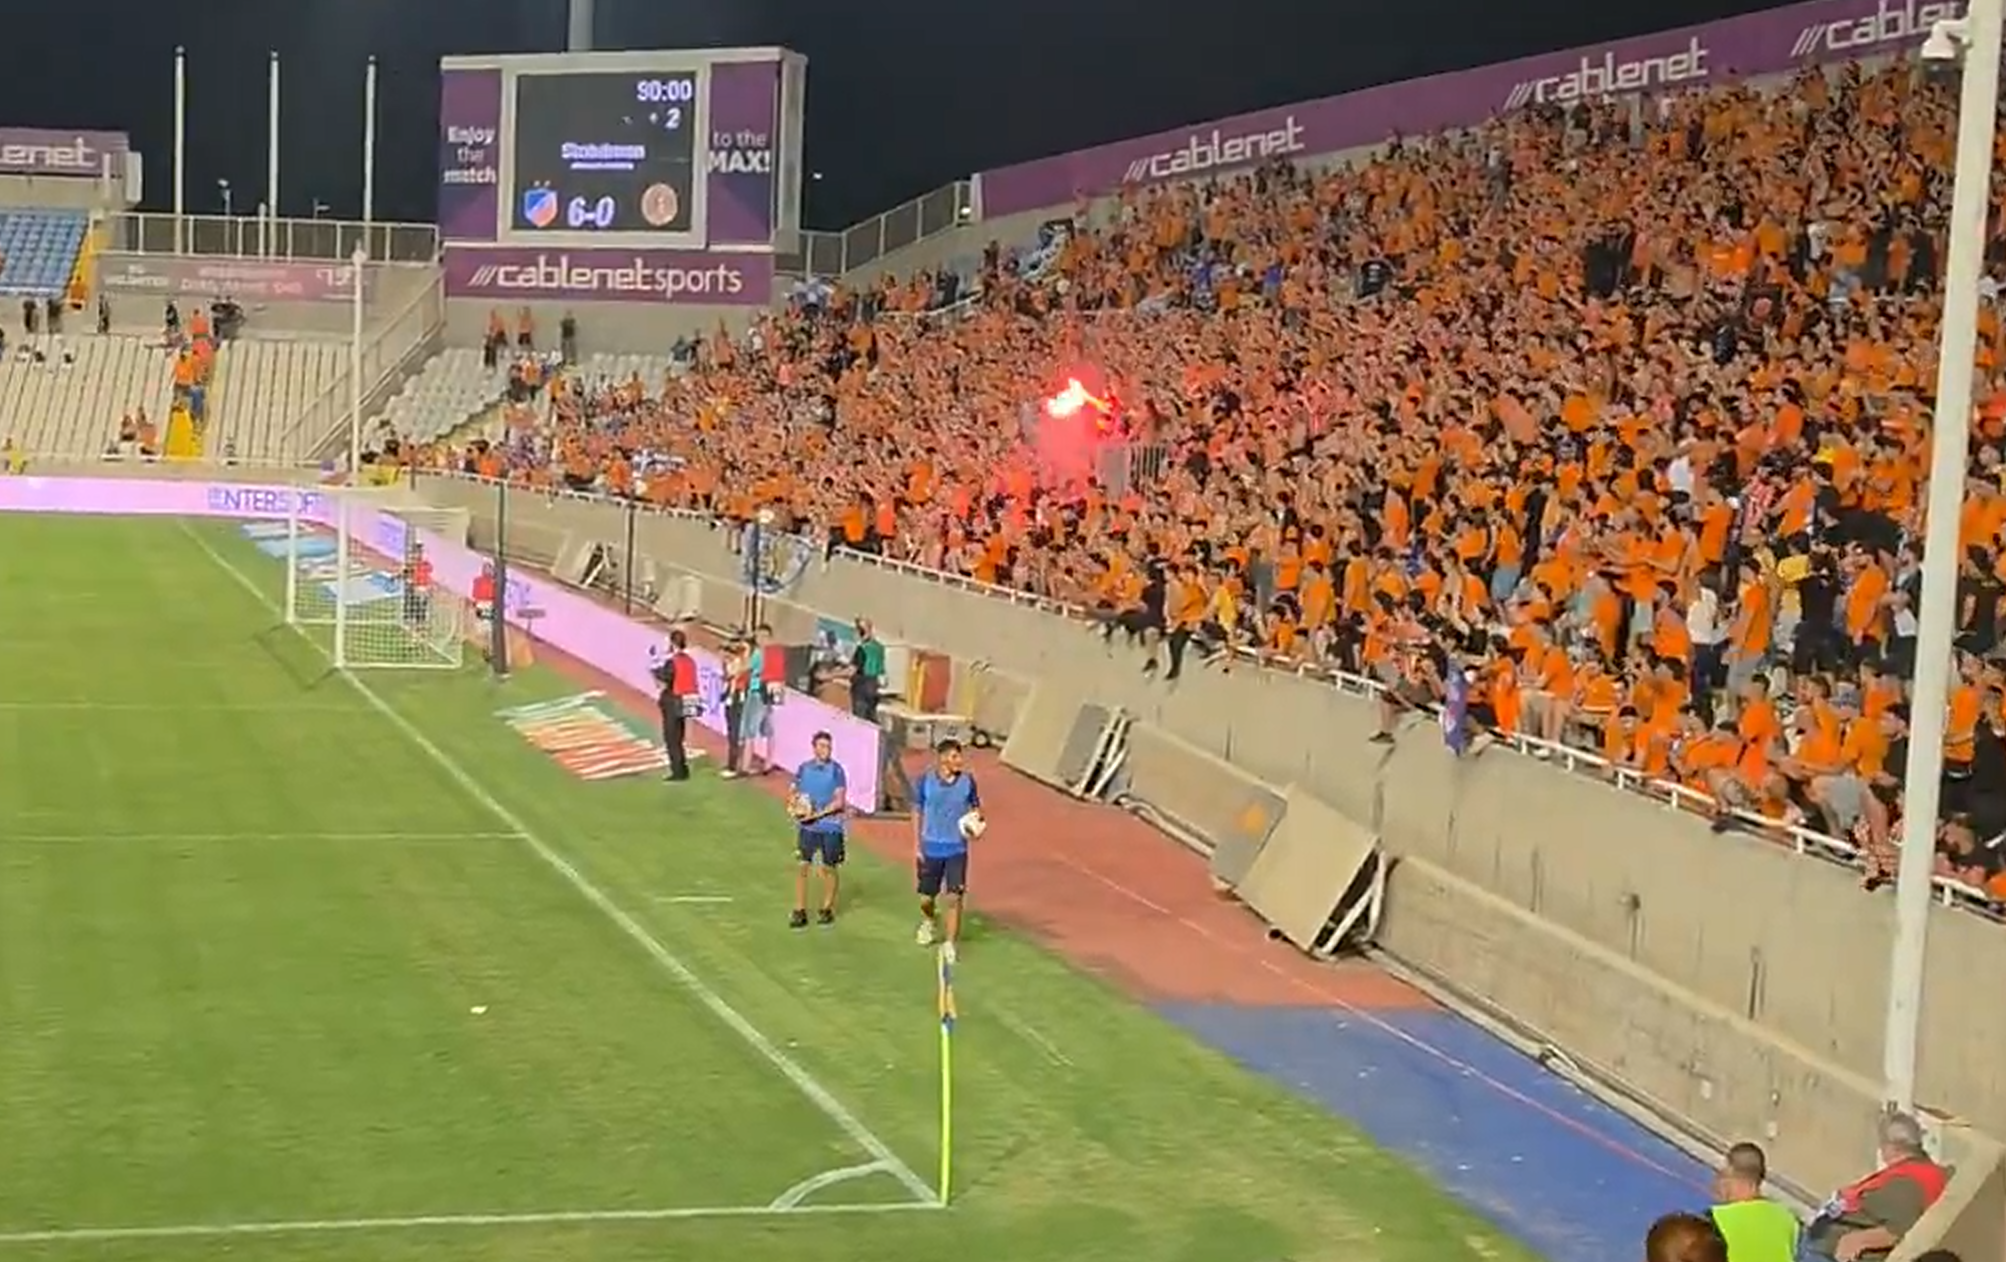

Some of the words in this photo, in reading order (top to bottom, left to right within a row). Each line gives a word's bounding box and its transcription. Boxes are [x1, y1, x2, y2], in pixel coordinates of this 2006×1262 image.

[1535, 37, 1709, 107] cablenet
[636, 79, 693, 102] 90:00
[447, 126, 495, 145] Enjoy
[713, 131, 731, 147] to
[736, 129, 767, 147] the
[0, 136, 98, 167] enet
[457, 147, 484, 163] the
[1150, 116, 1304, 180] cablenet
[707, 149, 771, 173] MAX!
[444, 166, 496, 184] match
[567, 196, 616, 227] 6-0
